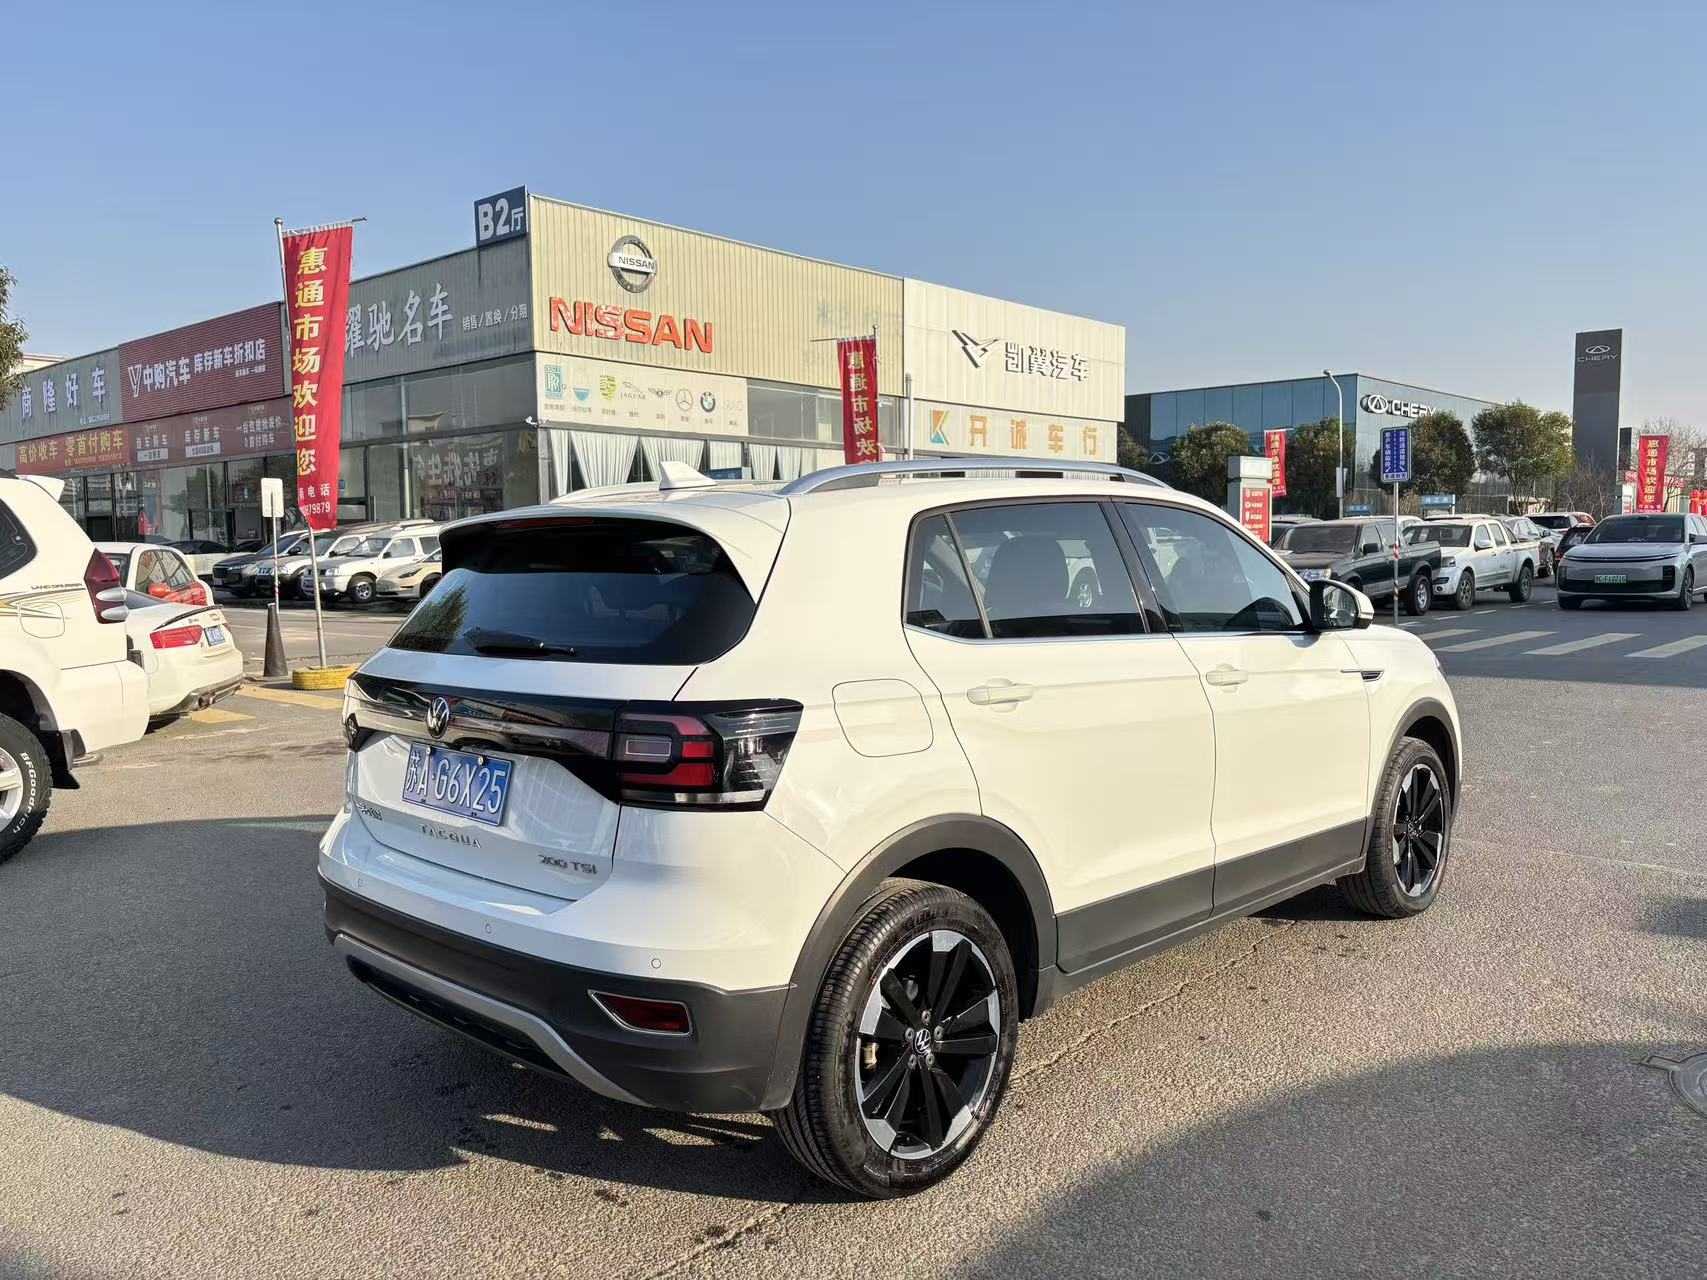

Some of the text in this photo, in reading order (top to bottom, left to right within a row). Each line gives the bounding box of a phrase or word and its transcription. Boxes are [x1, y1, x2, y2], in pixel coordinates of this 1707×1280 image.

[477, 198, 524, 241] B2厅
[617, 256, 656, 270] NISSAN
[549, 297, 714, 354] NISSAN
[143, 338, 266, 392] 中购汽车 库存新车折扣店
[292, 247, 328, 476] 惠通市场欢迎您
[1004, 342, 1090, 382] 凯翼汽车
[1577, 354, 1618, 363] CHERY
[1391, 400, 1437, 417] CHERY
[568, 860, 598, 875] TSI
